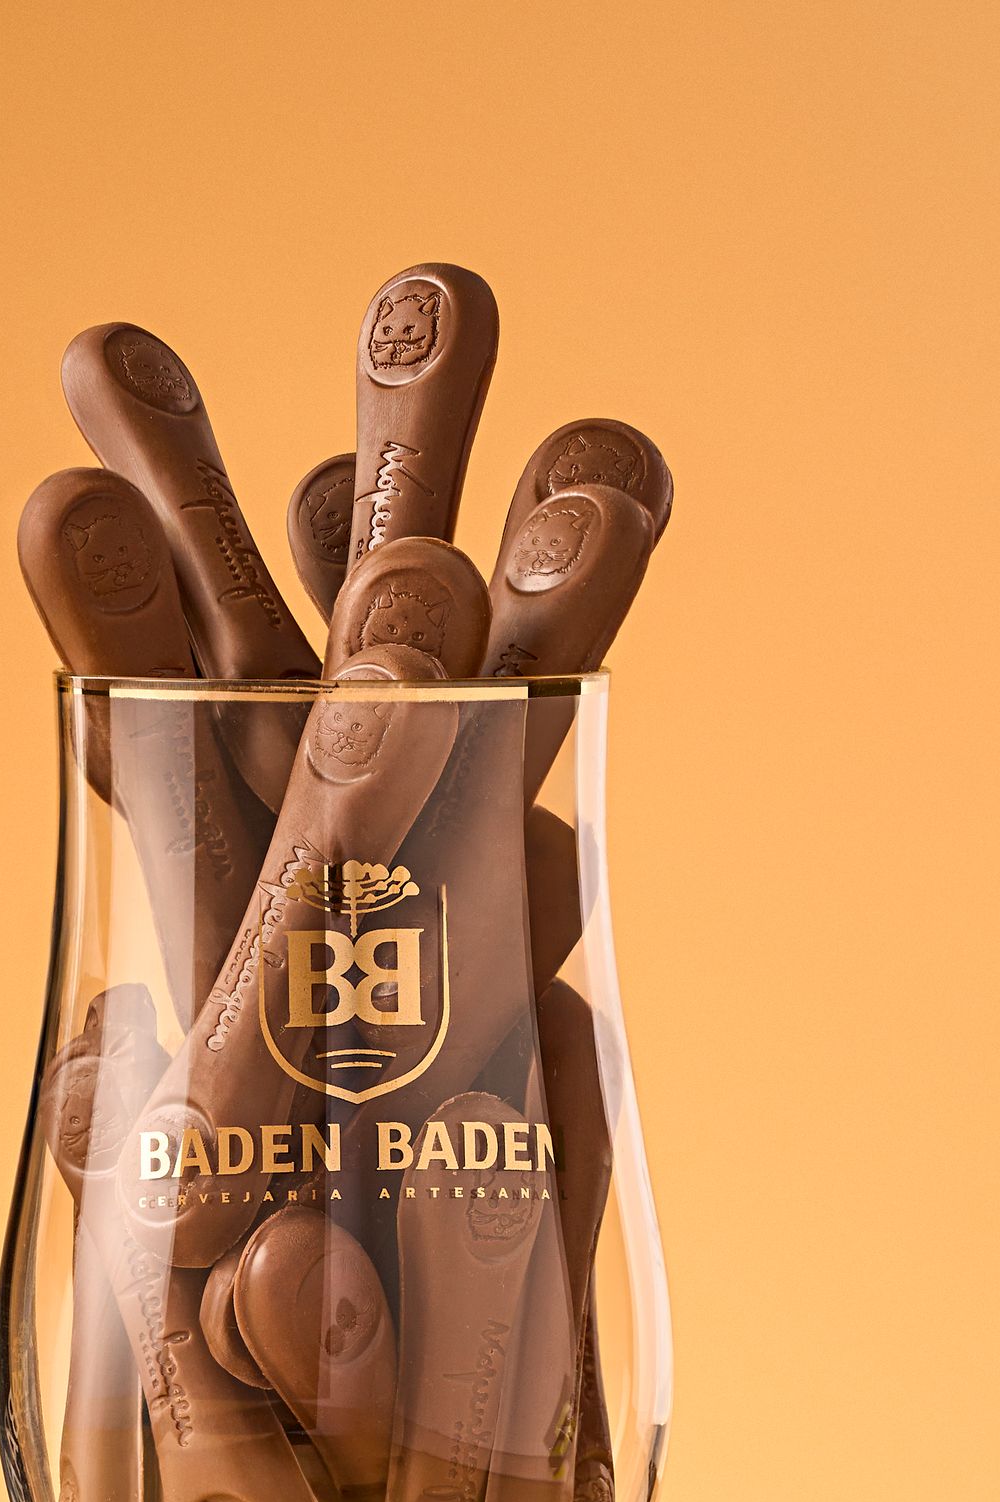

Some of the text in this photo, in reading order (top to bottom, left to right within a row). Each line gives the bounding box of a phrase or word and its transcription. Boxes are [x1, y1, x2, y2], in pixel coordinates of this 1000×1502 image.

[138, 1120, 566, 1181] BADEN BADEN
[138, 1186, 343, 1209] CERVEJARIA
